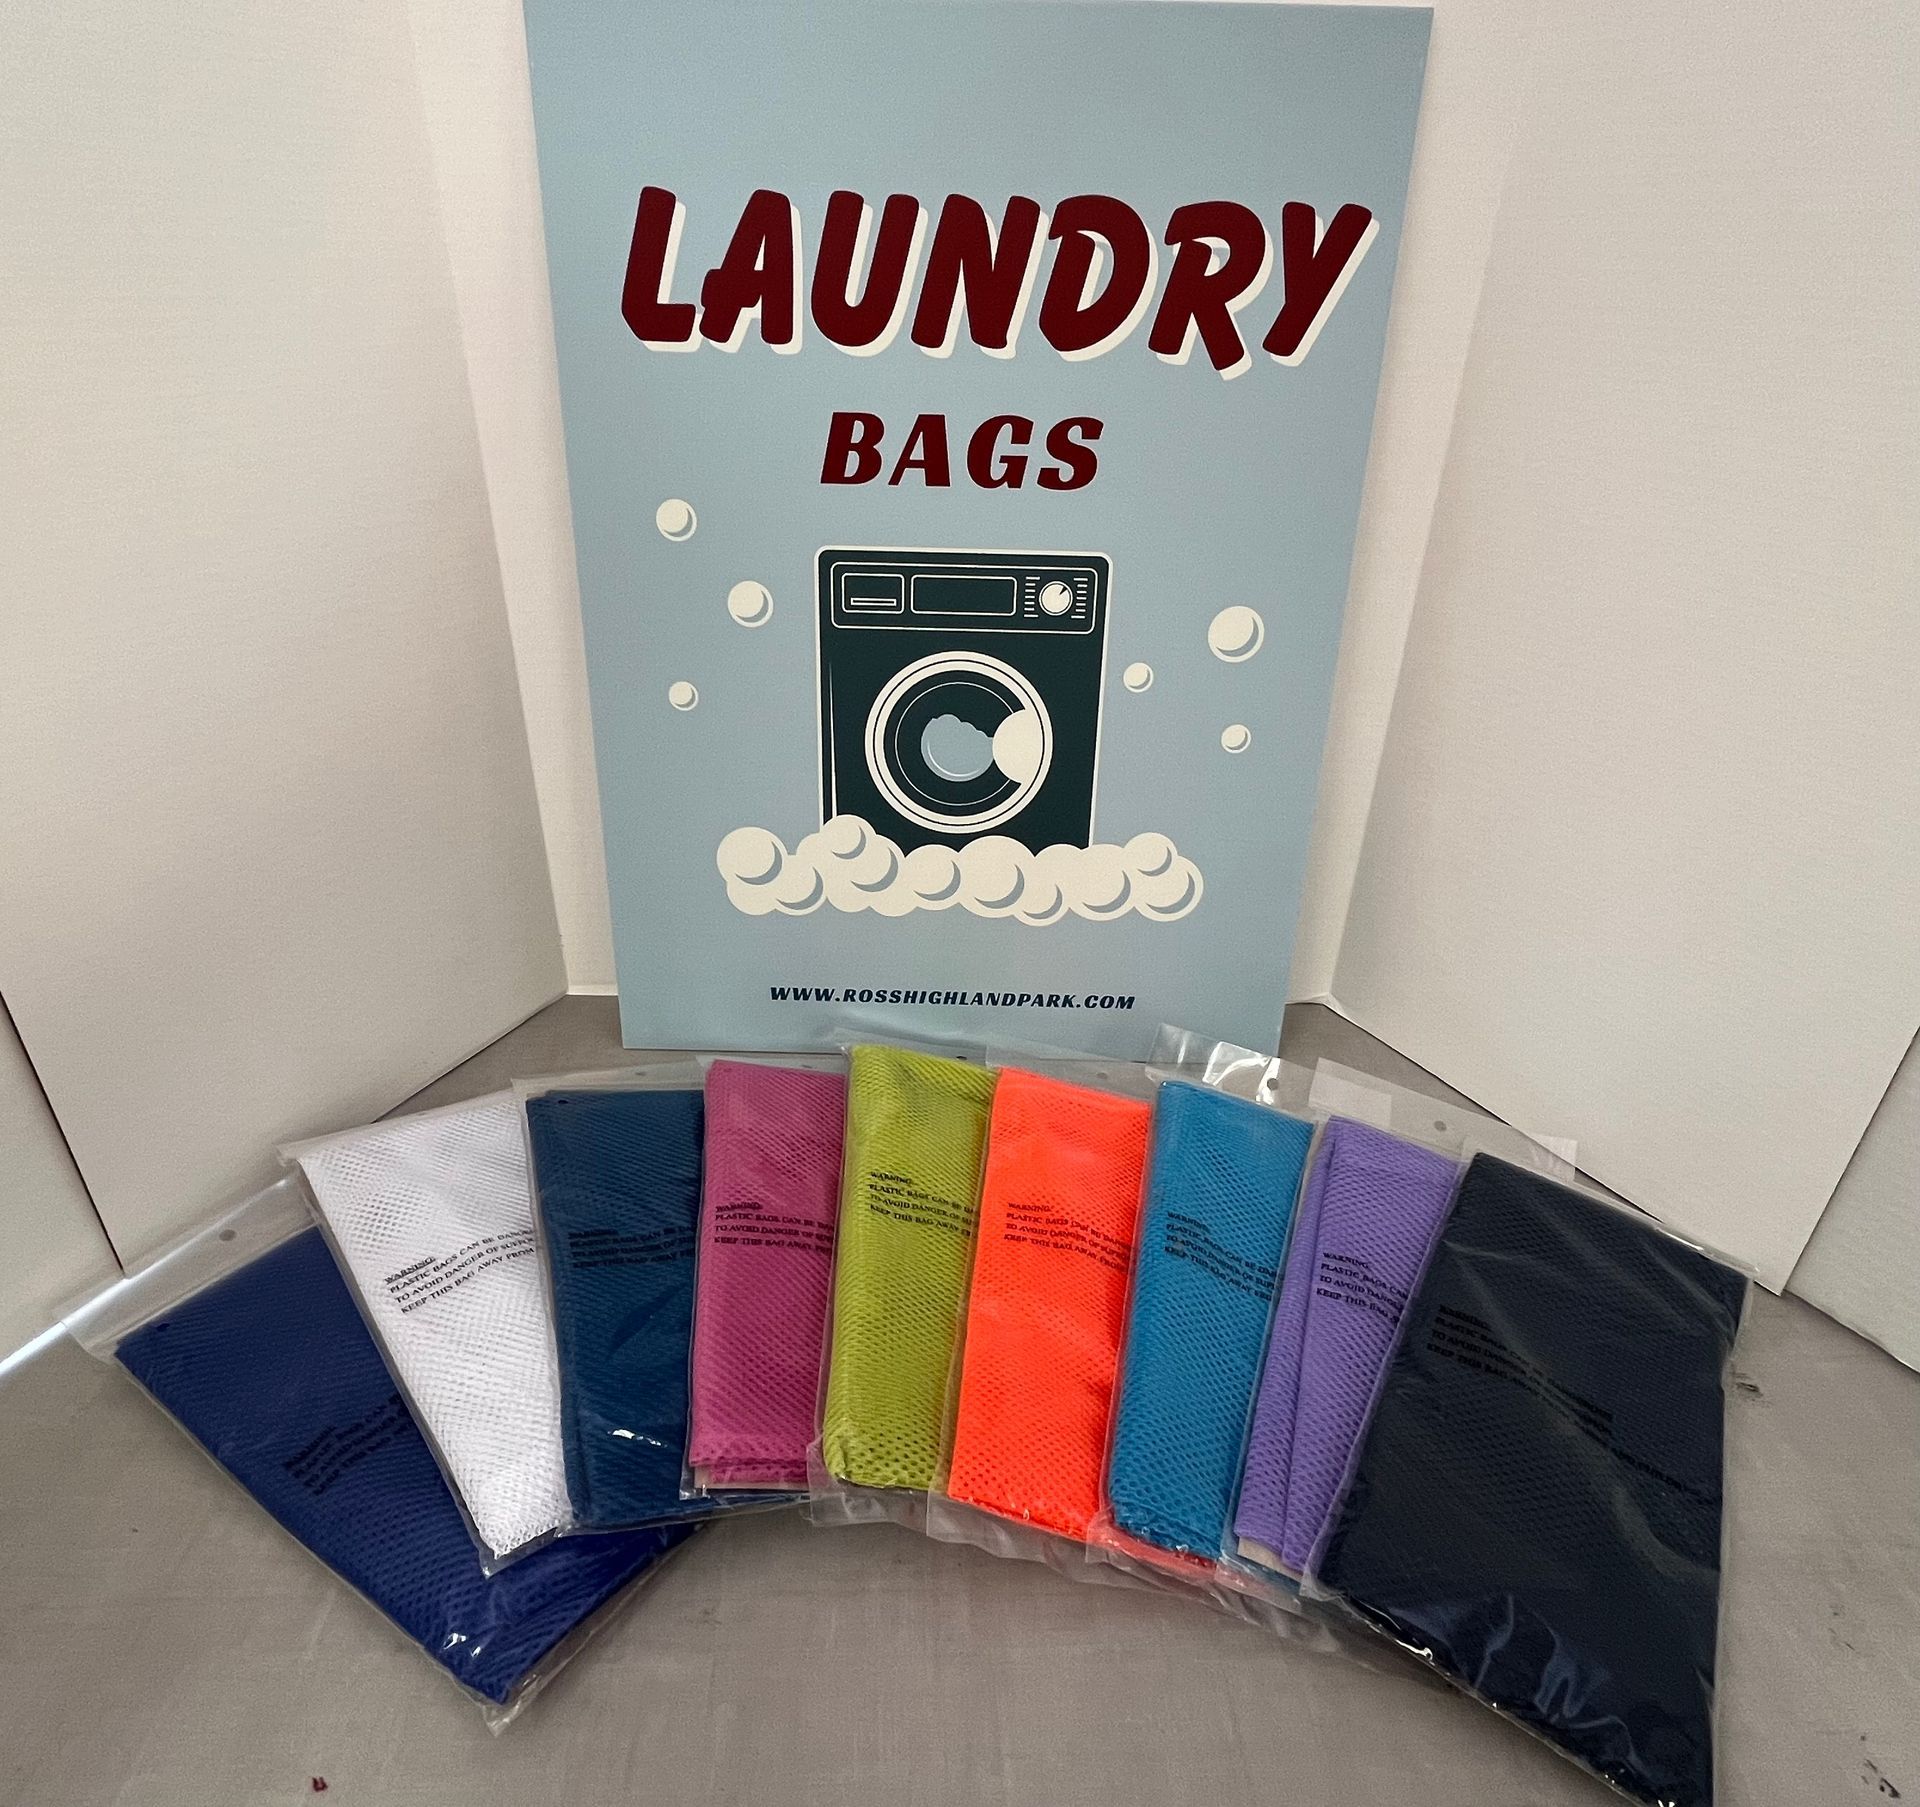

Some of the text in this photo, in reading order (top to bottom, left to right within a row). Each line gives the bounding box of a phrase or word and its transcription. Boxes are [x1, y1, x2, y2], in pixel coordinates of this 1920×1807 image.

[621, 186, 1376, 374] LAUNDRY
[820, 411, 1104, 490] BAGS
[770, 986, 1136, 1010] WWW.ROSSHIGHLANDPARK.COM
